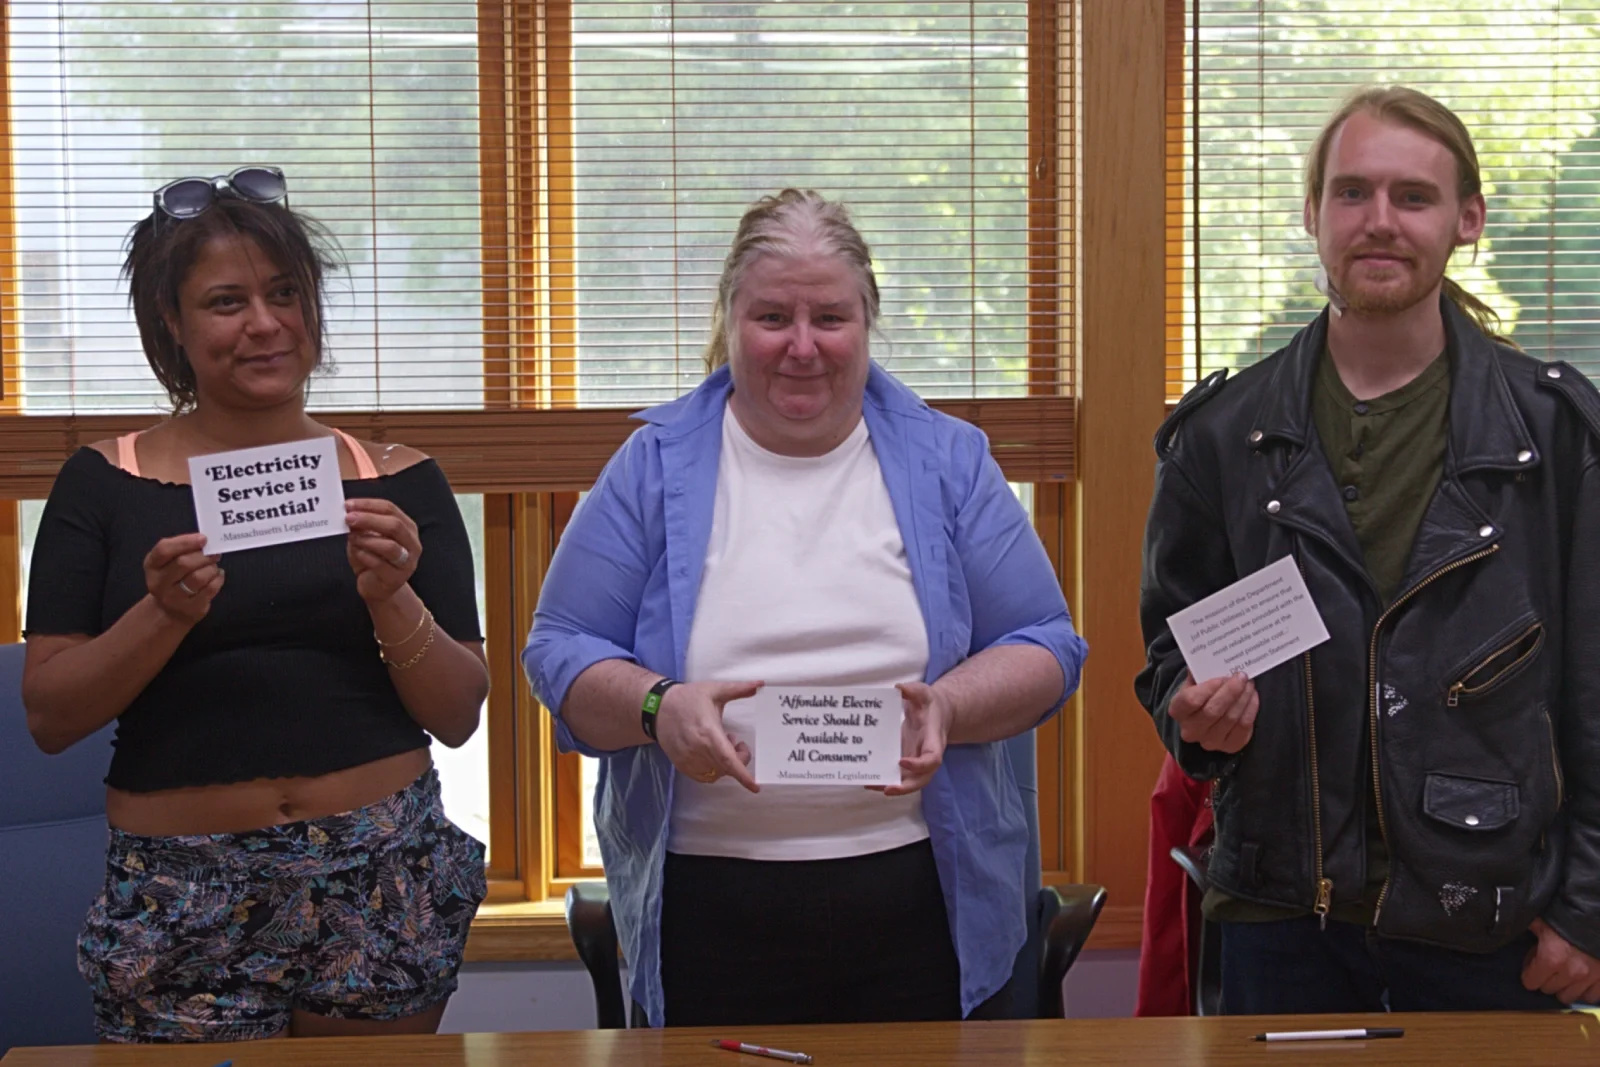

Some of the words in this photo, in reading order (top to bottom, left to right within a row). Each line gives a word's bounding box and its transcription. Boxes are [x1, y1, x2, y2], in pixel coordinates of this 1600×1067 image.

[205, 454, 322, 482] 'Electricity
[218, 481, 295, 503] Service
[300, 476, 317, 491] is
[220, 497, 320, 526] Essential'
[284, 518, 329, 533] Legislature
[1246, 576, 1283, 599] Department
[1200, 623, 1220, 636] Public
[1279, 585, 1293, 596] that
[1251, 604, 1280, 624] provided
[1280, 599, 1294, 609] with
[1293, 593, 1304, 602] the
[1228, 633, 1252, 649] reliable
[1251, 623, 1274, 636] service
[1280, 613, 1292, 622] the
[1244, 637, 1271, 656] possible
[1268, 635, 1300, 655] Statement
[778, 695, 839, 709] 'Affordable
[842, 695, 883, 709] Electric
[781, 713, 819, 726] Service
[822, 713, 860, 726] Should
[864, 714, 878, 726] Be
[796, 731, 849, 744] Available
[852, 734, 863, 744] to
[787, 749, 804, 762] All
[808, 750, 872, 763] Consumers'
[837, 770, 881, 781] Legislature
